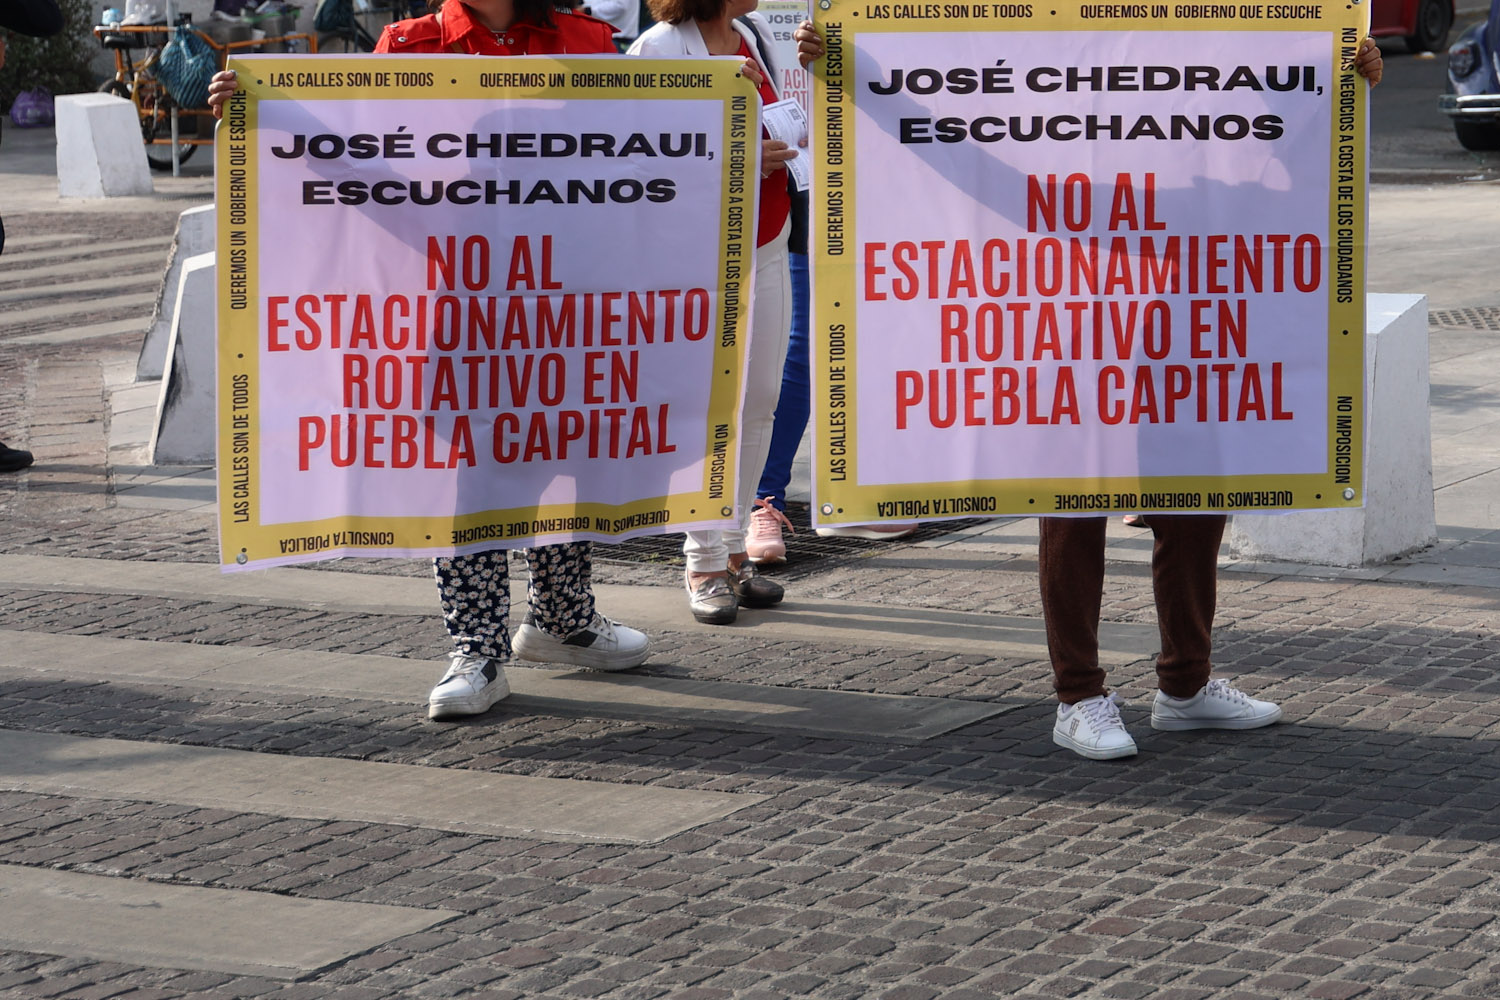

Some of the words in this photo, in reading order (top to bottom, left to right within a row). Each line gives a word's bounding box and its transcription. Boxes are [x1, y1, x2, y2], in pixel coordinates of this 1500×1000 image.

[767, 11, 803, 25] JOSÉ
[866, 4, 890, 19] LAS
[893, 4, 941, 19] CALLES
[943, 4, 969, 18] SON
[972, 4, 989, 18] DE
[991, 3, 1033, 18] TODOS
[1080, 4, 1148, 19] QUEREMOS
[1150, 4, 1168, 18] UN
[1174, 4, 1236, 19] GOBIERNO
[1239, 4, 1263, 19] QUE
[1266, 4, 1322, 19] ESCUCHE
[1341, 27, 1357, 43] NO
[825, 21, 843, 77] ESCUCHE
[1340, 46, 1357, 70] MAS
[270, 72, 294, 87] LAS
[296, 71, 344, 87] CALLES
[346, 71, 371, 87] SON
[374, 71, 391, 87] DE
[393, 71, 434, 87] TODOS
[479, 72, 546, 88] QUEREMOS
[548, 72, 565, 88] UN
[570, 72, 631, 88] GOBIERNO
[633, 72, 657, 88] QUE
[659, 73, 713, 88] ESCUCHE
[867, 58, 1014, 95] JOSÉ
[1025, 65, 1323, 96] CHEDRAUI,
[824, 78, 843, 103] QUE
[1339, 73, 1356, 131] NEGOCIOS
[731, 95, 747, 111] NO
[730, 113, 746, 138] MAS
[825, 105, 843, 165] GOBIERNO
[899, 113, 1284, 144] ESCUCHANOS
[270, 125, 415, 160] JOSÉ
[425, 132, 714, 161] CHEDRAUI,
[1338, 134, 1354, 143] A
[728, 140, 745, 194] NEGOCIOS
[1338, 144, 1354, 183] COSTA
[826, 171, 843, 188] UN
[302, 178, 676, 206] ESCUCHANOS
[728, 195, 743, 204] A
[1026, 172, 1092, 233] NO
[1107, 172, 1165, 231] AL
[1338, 185, 1353, 201] DE
[727, 205, 743, 241] COSTA
[826, 190, 844, 256] QUEREMOS
[1337, 203, 1353, 226] LOS
[726, 242, 742, 257] DE
[426, 234, 490, 292] NO
[505, 234, 562, 291] AL
[725, 259, 741, 280] LOS
[863, 232, 1321, 301] ESTACIONAMIENTO
[1336, 228, 1353, 303] CIUDADANOS
[267, 287, 710, 352] ESTACIONAMIENTO
[721, 281, 740, 348] CIUDADANOS
[940, 299, 1171, 363] ROTATIVO
[1189, 298, 1247, 359] EN
[828, 323, 845, 363] TODOS
[342, 352, 566, 411] ROTATIVO
[582, 349, 639, 405] EN
[829, 365, 846, 381] DE
[829, 384, 846, 408] SON
[895, 365, 1081, 430] PUEBLA
[1096, 361, 1294, 425] CAPITAL
[1336, 395, 1353, 412] NO
[298, 413, 477, 471] PUEBLA
[491, 402, 677, 464] CAPITAL
[714, 423, 728, 439] NO
[829, 410, 846, 456] CALLES
[1334, 414, 1352, 484] IMPOSICION
[708, 440, 728, 499] IMPOSICION
[829, 458, 846, 481] LAS
[876, 499, 930, 519] PÚBLICA
[932, 495, 996, 514] CONSULTA
[1054, 493, 1110, 510] ESCUCHE
[1112, 492, 1137, 509] QUE
[1139, 491, 1201, 509] GOBIERNO
[1207, 492, 1224, 508] UN
[1226, 489, 1293, 508] QUEREMOS
